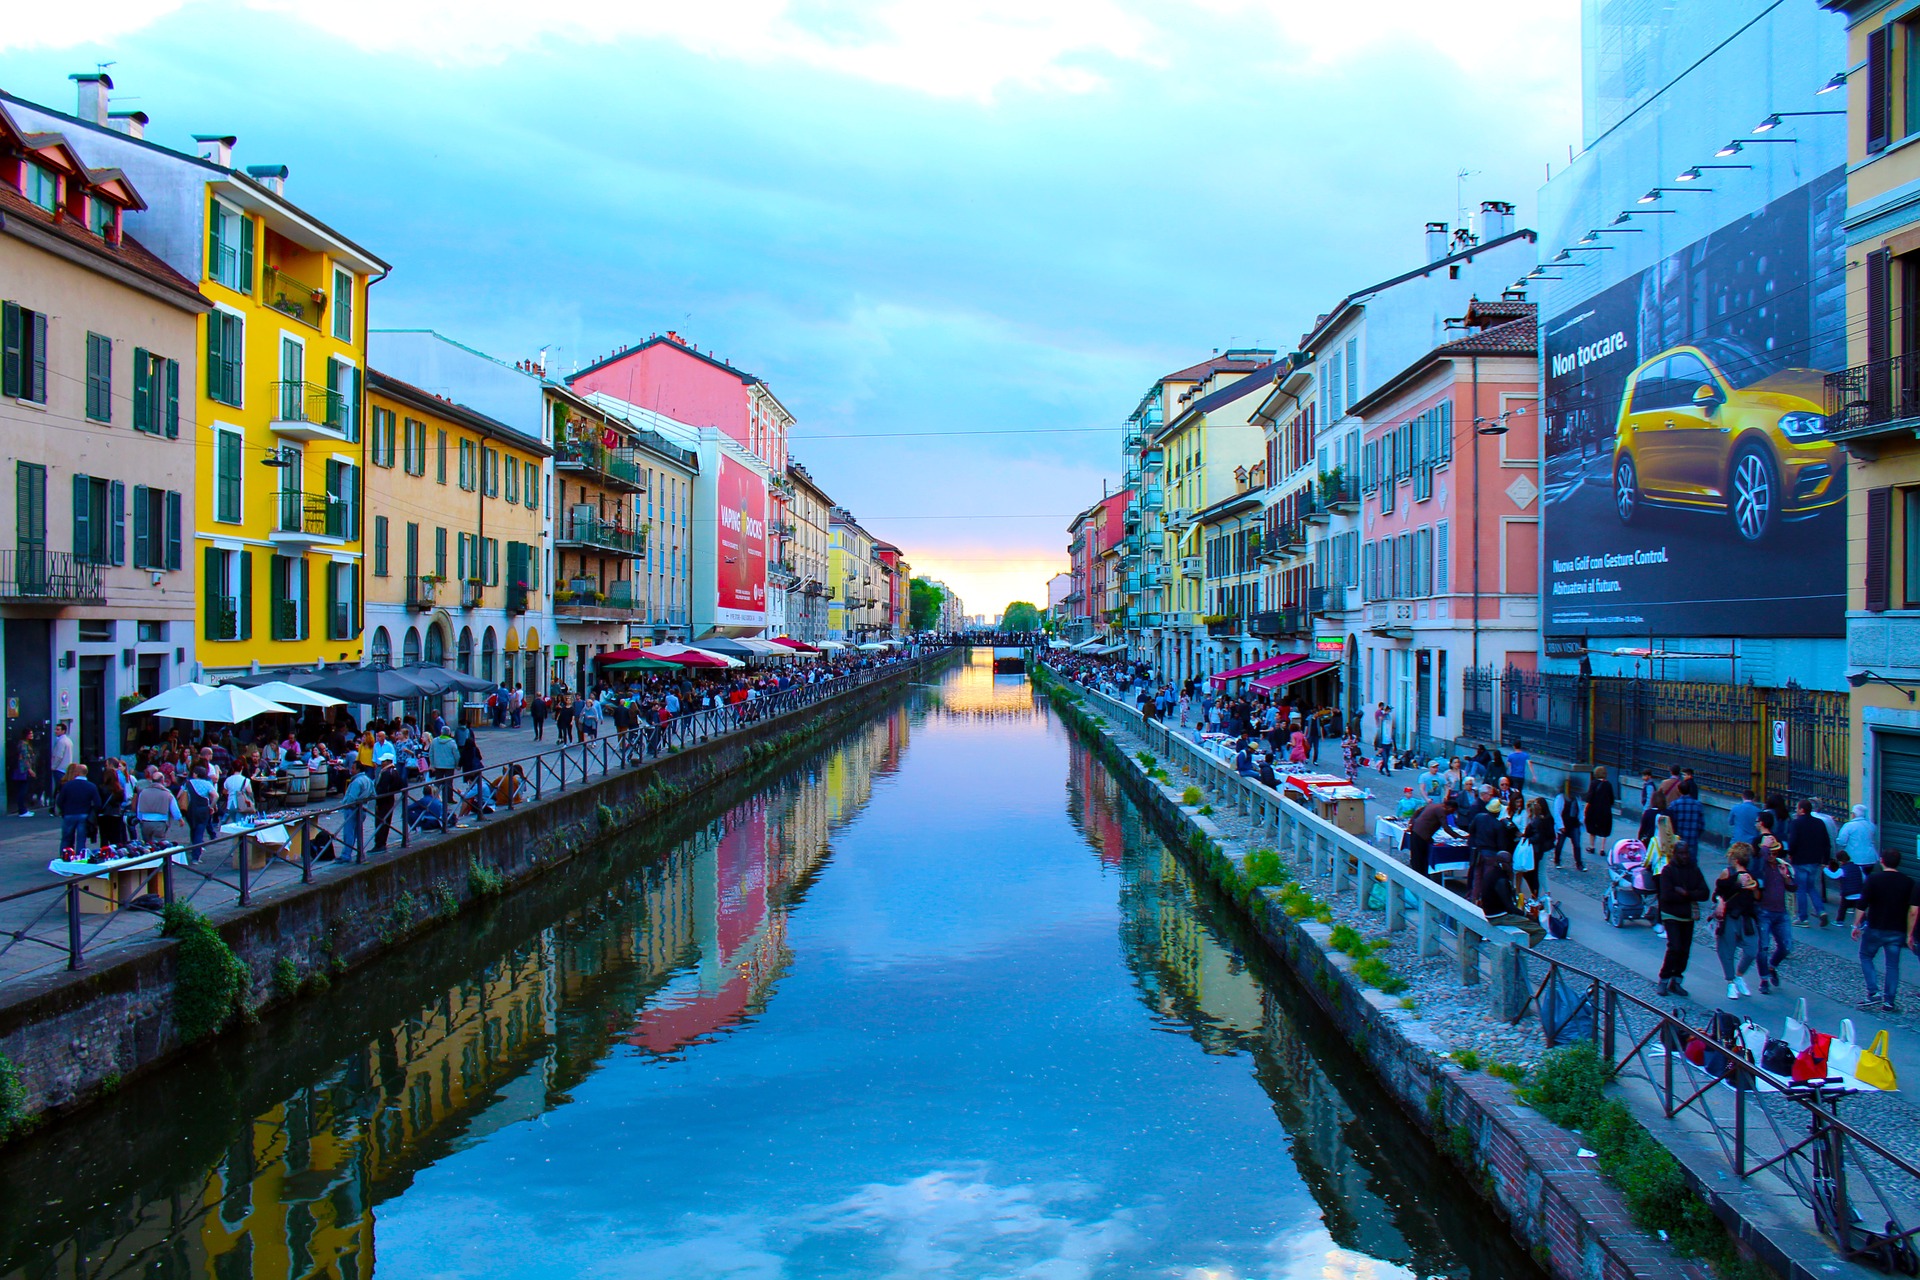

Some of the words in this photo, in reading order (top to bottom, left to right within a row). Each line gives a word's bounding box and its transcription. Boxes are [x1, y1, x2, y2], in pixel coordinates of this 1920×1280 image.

[1552, 353, 1576, 379] Non
[1577, 331, 1628, 367] toccare.
[721, 504, 741, 533] VAPING
[746, 516, 762, 540] ROCKS
[1552, 559, 1574, 573] Nuova
[1574, 556, 1590, 571] Golf
[1589, 557, 1603, 570] con
[1603, 553, 1634, 568] Gesture
[1634, 546, 1669, 565] Control.
[1552, 578, 1588, 595] Abituatevi
[1595, 578, 1622, 592] futuro.
